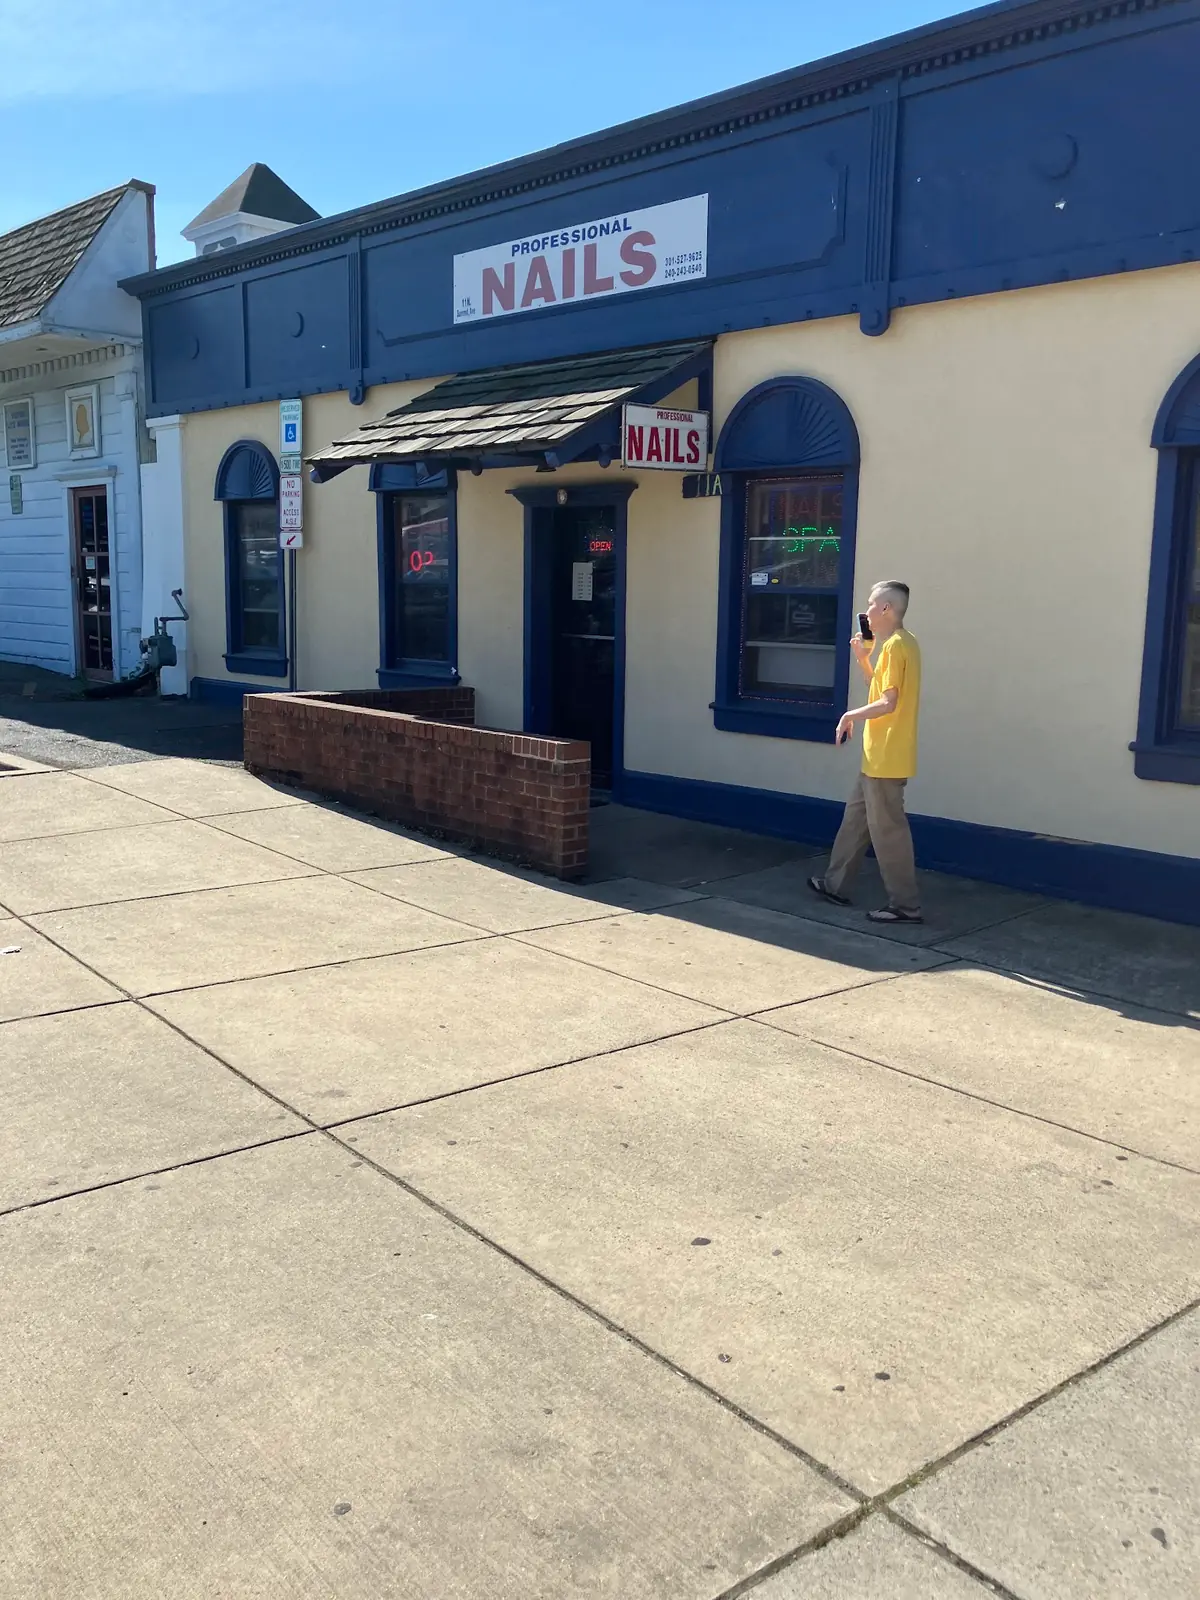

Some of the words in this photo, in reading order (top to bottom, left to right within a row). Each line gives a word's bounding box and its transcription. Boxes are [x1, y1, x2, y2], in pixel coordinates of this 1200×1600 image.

[511, 217, 633, 257] PROFESSIONAL
[481, 230, 658, 315] NAILS
[656, 410, 694, 423] PROFESSIONAL
[627, 425, 701, 464] NAILS
[286, 479, 296, 489] NO
[282, 490, 300, 498] PARKING
[283, 508, 300, 517] ACCESS
[589, 541, 612, 551] OPEN
